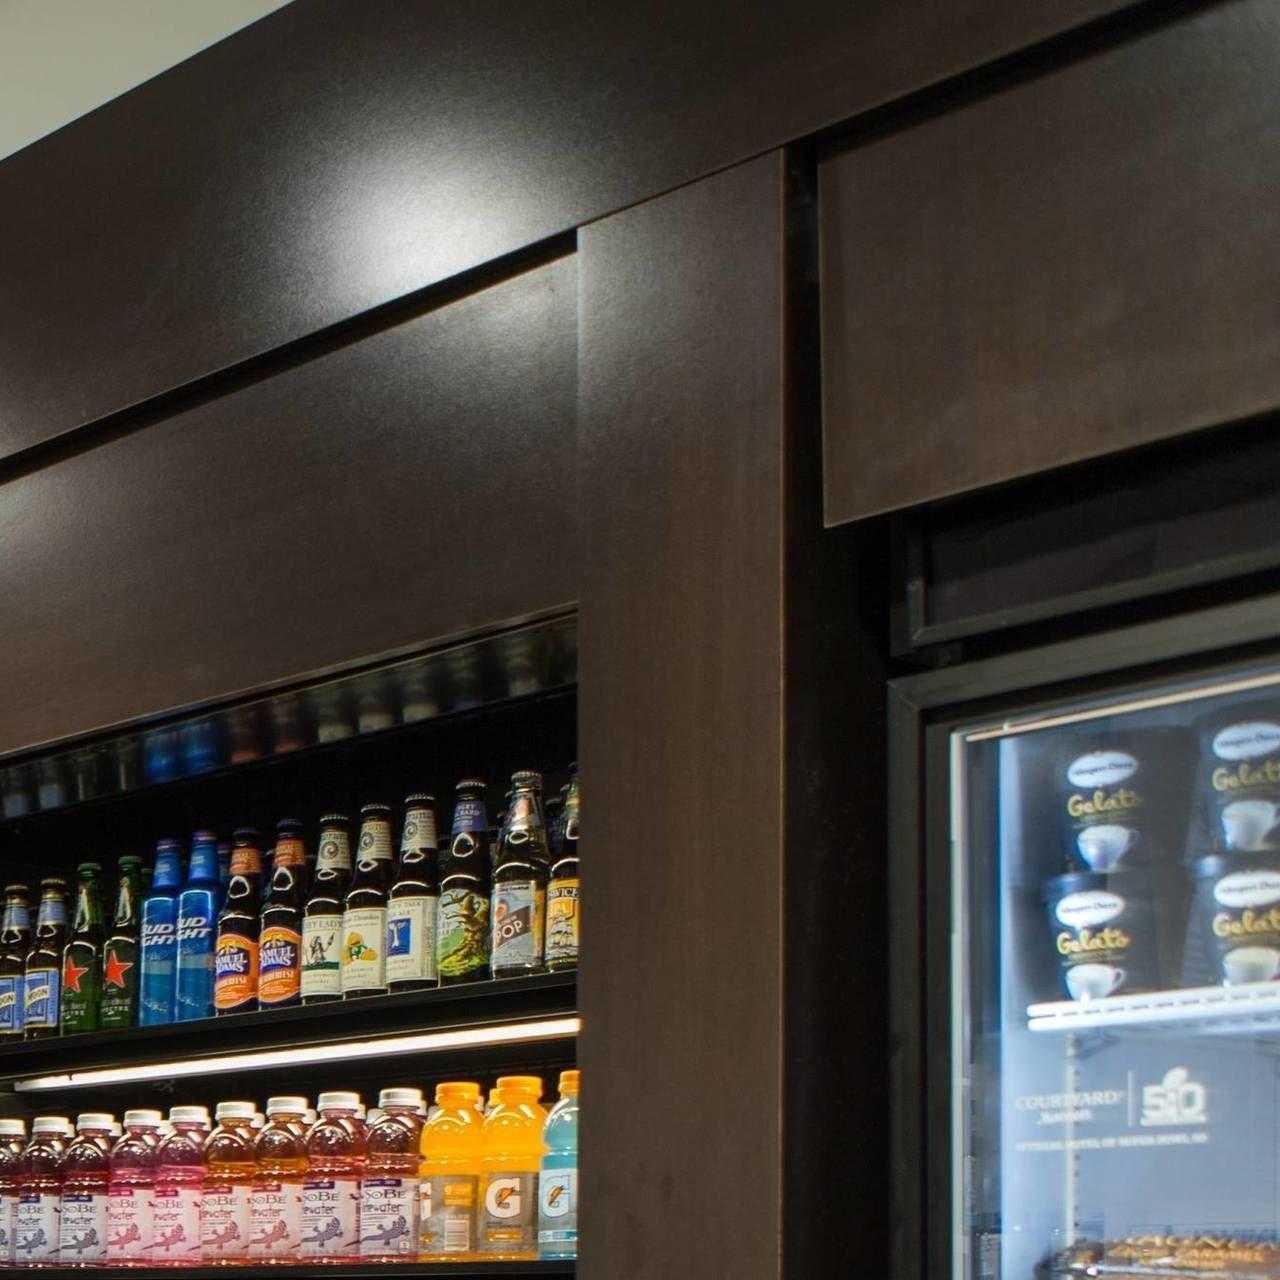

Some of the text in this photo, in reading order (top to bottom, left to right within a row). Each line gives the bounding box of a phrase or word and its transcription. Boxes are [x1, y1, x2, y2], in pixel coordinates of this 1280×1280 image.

[1212, 758, 1280, 792] Gelat
[1212, 908, 1280, 938] Gelat
[143, 934, 176, 946] GHT
[1057, 927, 1130, 955] Gelato
